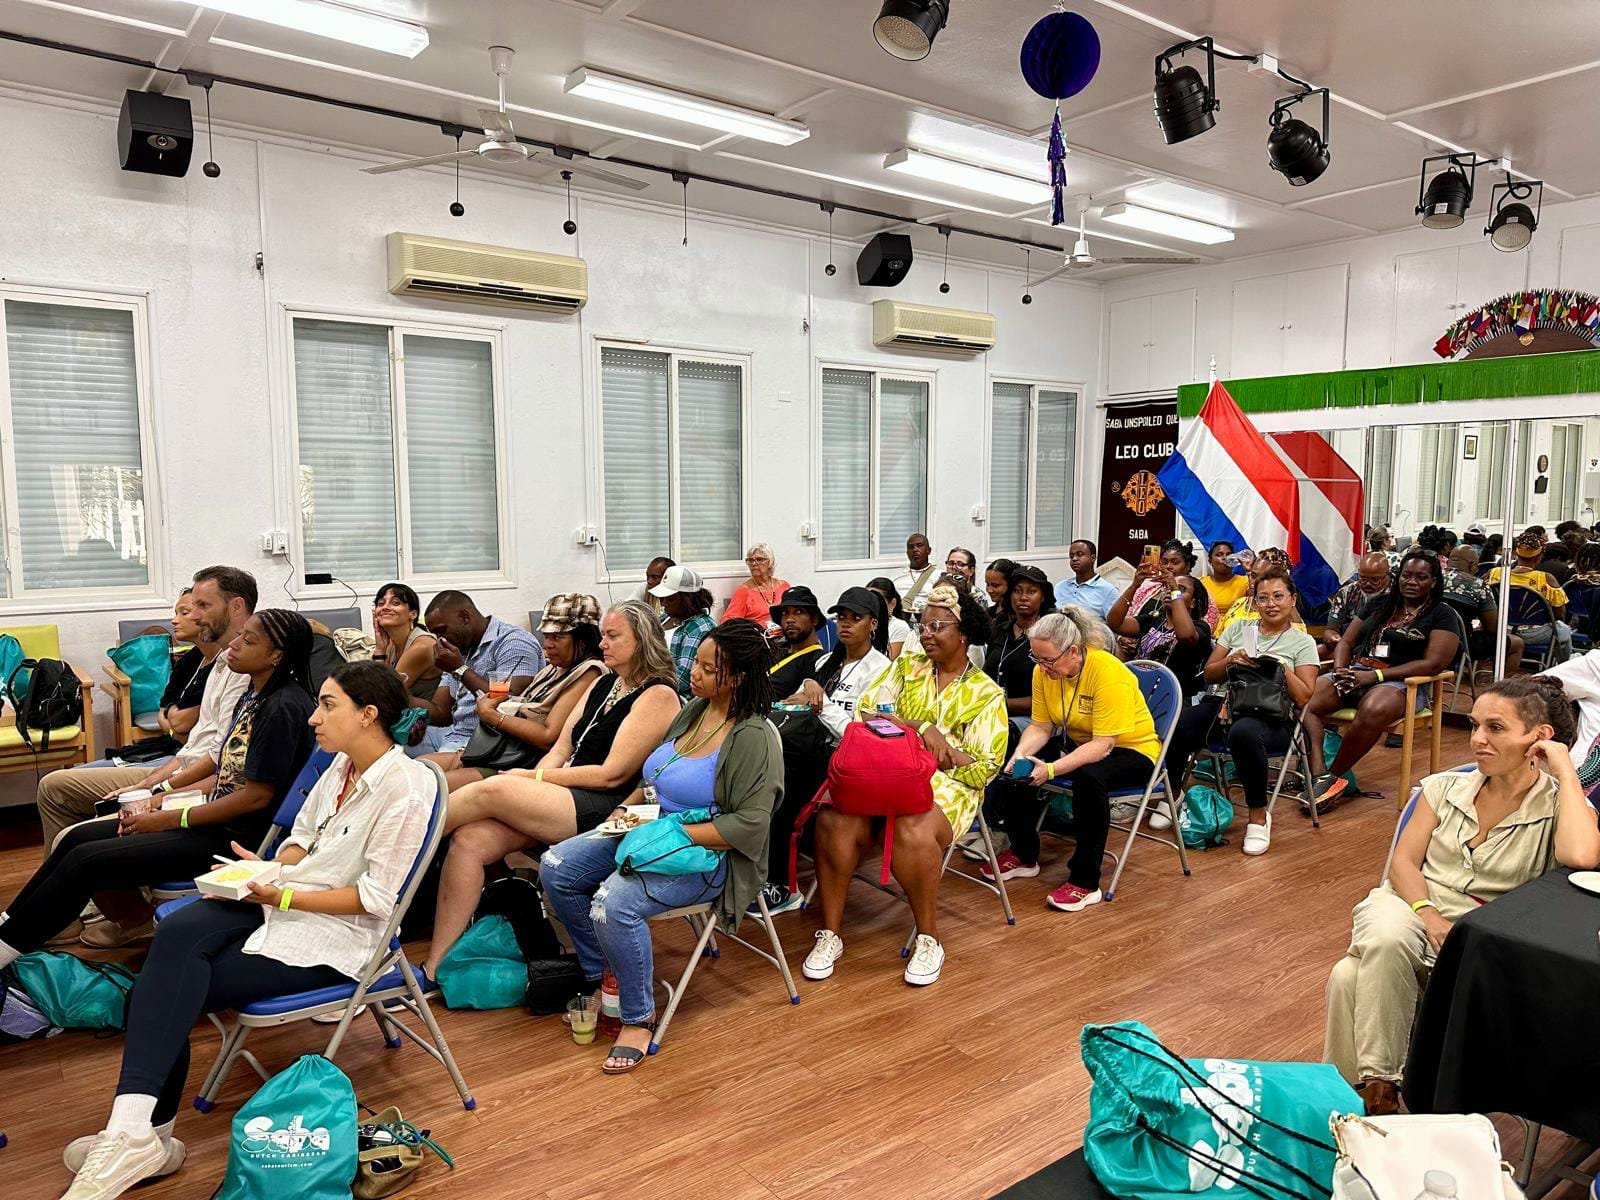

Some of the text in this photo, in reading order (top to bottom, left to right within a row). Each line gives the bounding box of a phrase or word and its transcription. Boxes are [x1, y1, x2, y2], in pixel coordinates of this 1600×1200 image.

[1105, 418, 1123, 429] SABA
[1124, 415, 1163, 429] UNSPOILED
[1115, 442, 1174, 459] LEO CLUB
[1138, 472, 1148, 514] LEO
[1128, 528, 1149, 540] SABA
[241, 1115, 330, 1153] Saba
[1246, 1132, 1261, 1173] DUTH
